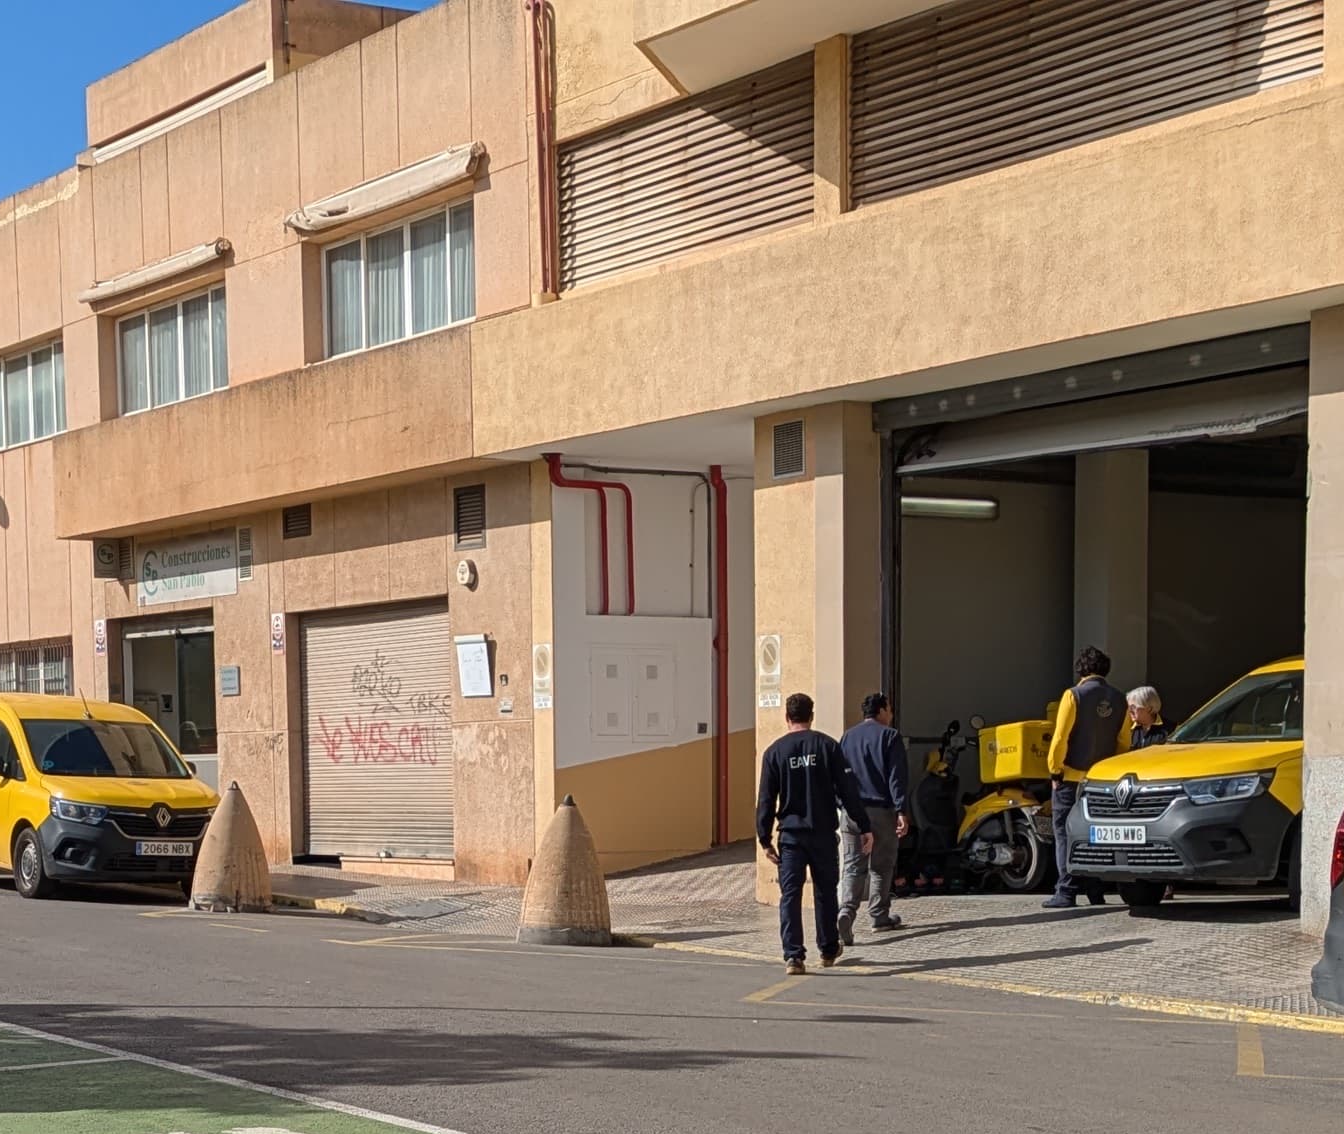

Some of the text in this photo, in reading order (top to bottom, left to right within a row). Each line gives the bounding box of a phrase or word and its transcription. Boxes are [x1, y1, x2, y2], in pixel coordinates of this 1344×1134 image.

[161, 543, 232, 568] Construcciones
[162, 570, 205, 591] San Pablo
[789, 754, 816, 769] EAVE
[1096, 827, 1121, 841] 0216
[143, 843, 191, 855] 2066 NBX
